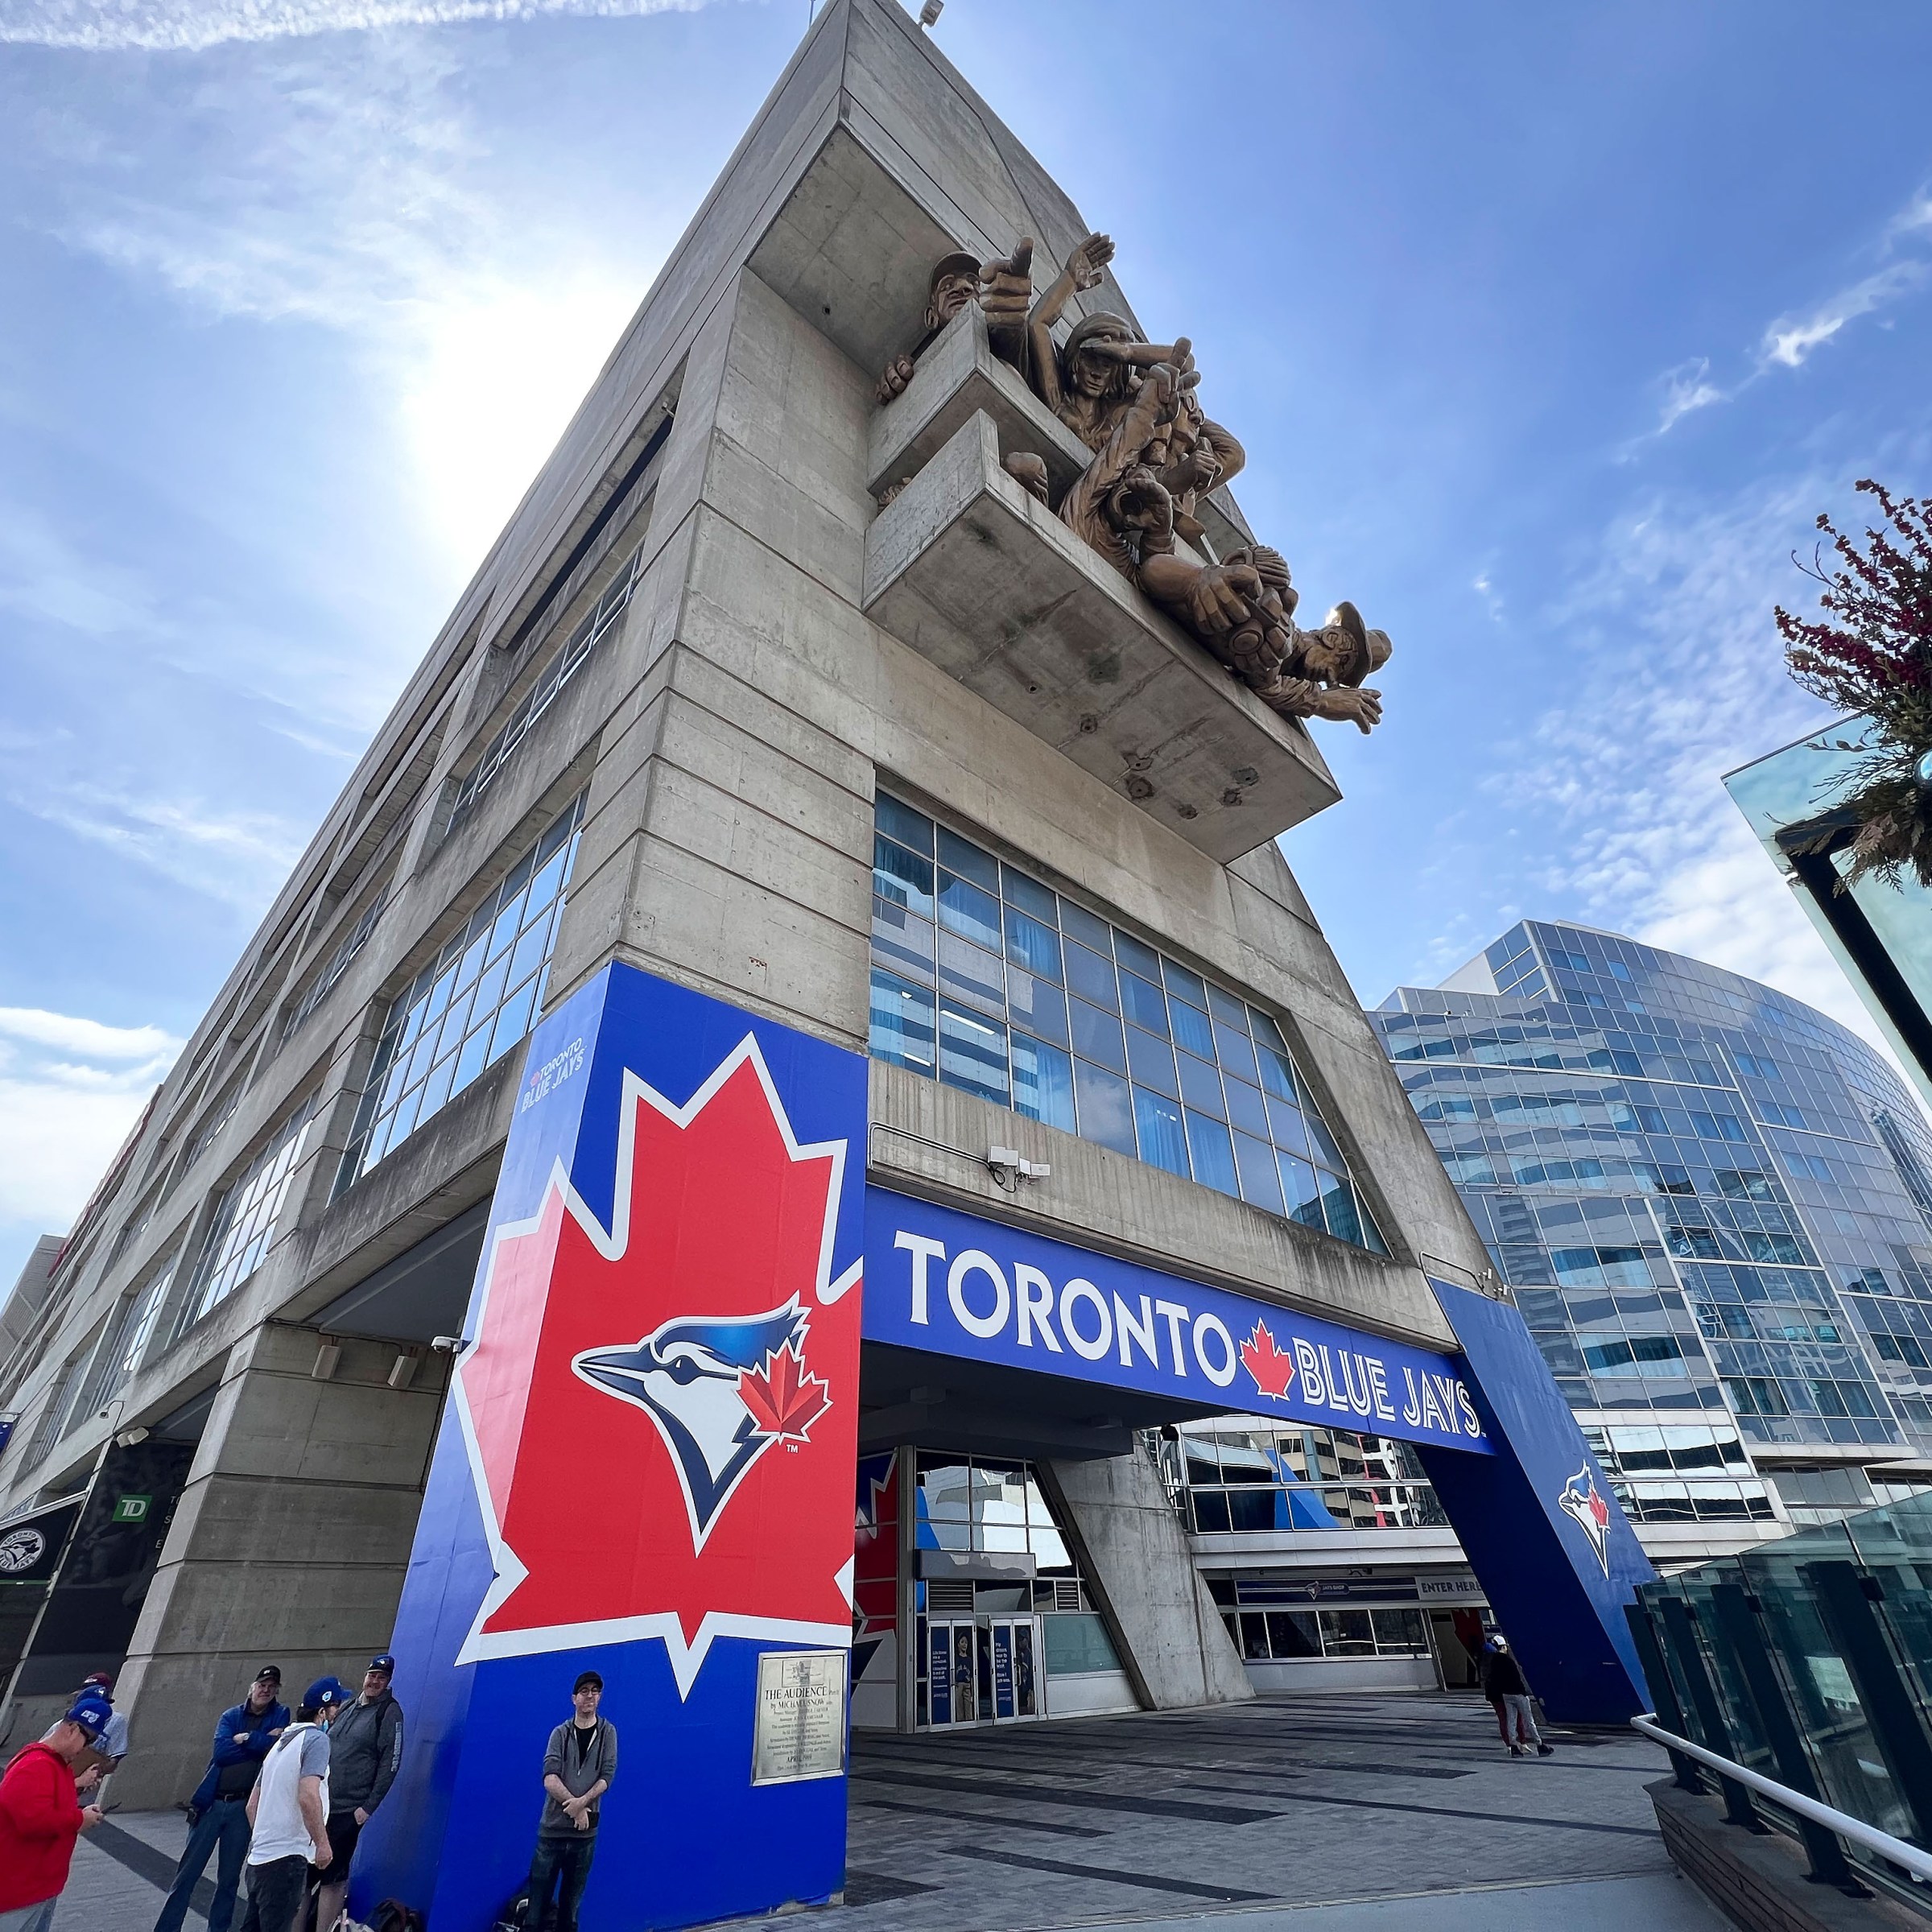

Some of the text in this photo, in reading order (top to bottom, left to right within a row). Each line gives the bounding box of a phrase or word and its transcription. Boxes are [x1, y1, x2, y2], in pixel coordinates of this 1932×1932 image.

[540, 1037, 583, 1080] TORONTO
[521, 1047, 585, 1114] BLUE JAYS
[894, 1229, 1480, 1439] TORONTO BLUE JAYS
[786, 1444, 799, 1453] TM
[122, 1499, 147, 1517] TD
[1421, 1582, 1455, 1593] ENTER
[765, 1689, 782, 1700] THE
[783, 1686, 828, 1699] AUDIENCE
[807, 1698, 825, 1707] SNOW
